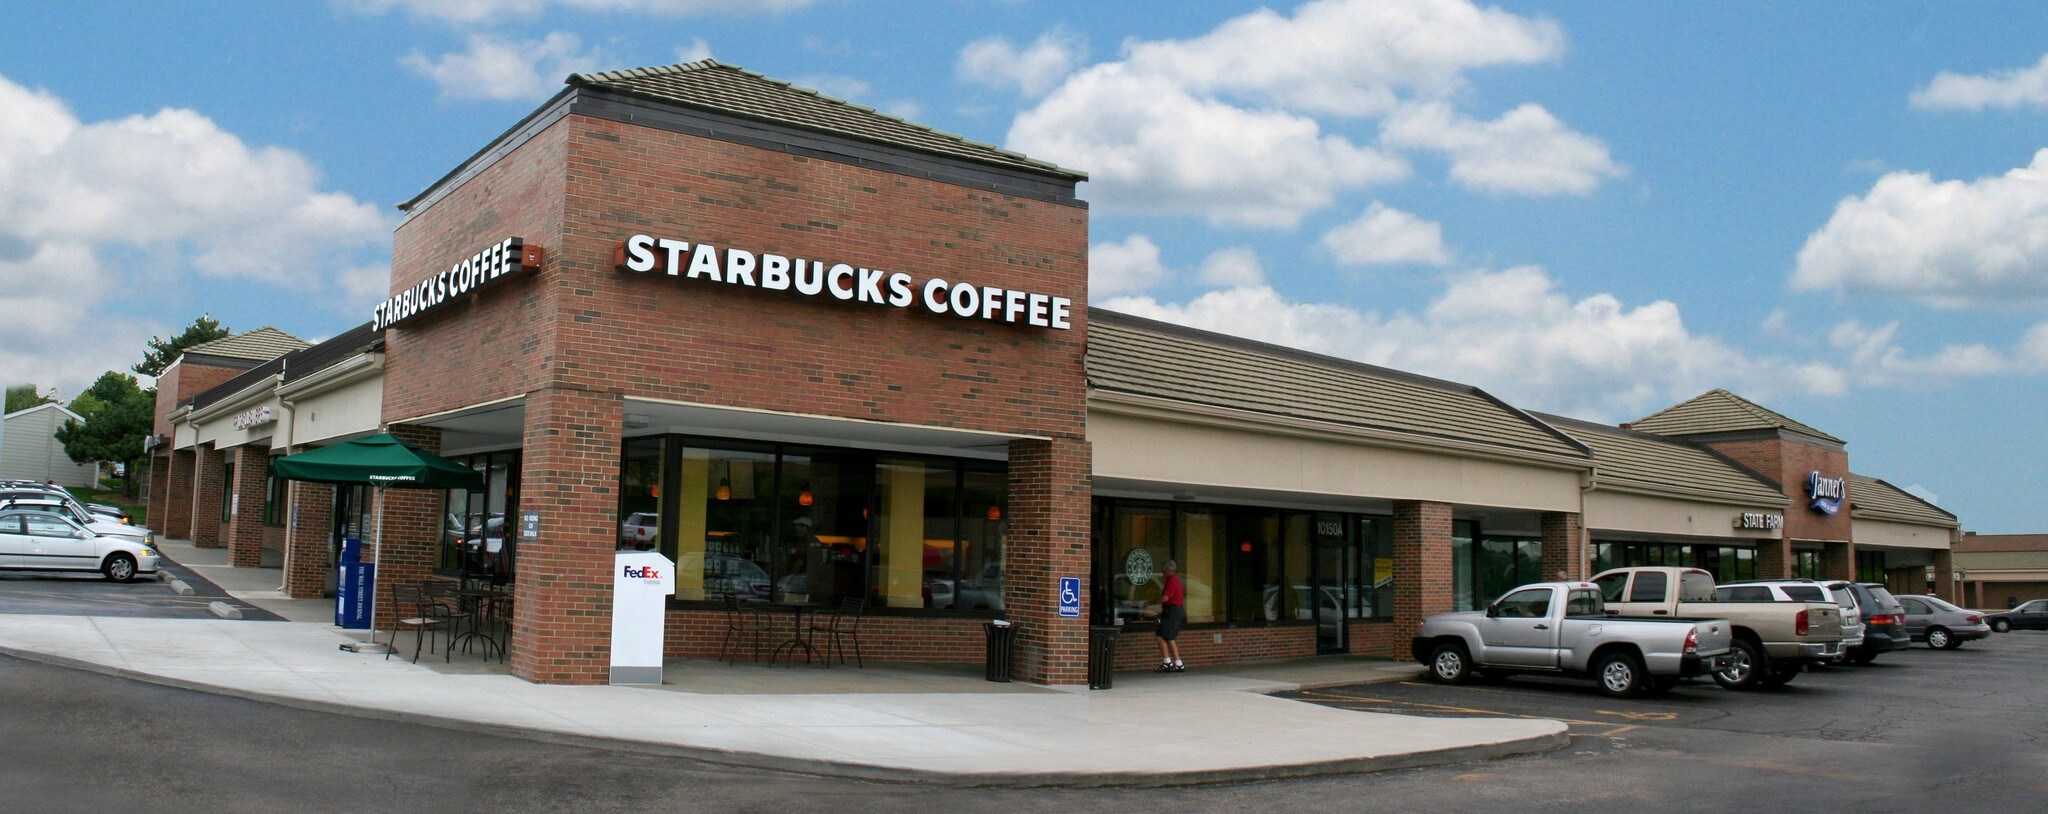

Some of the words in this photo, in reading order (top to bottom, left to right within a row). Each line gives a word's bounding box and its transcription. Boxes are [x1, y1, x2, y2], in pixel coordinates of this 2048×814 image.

[372, 271, 446, 332] STARBUCKS
[450, 237, 512, 297] COFFEE
[627, 234, 913, 307] STARBUCKS
[923, 278, 1071, 330] COFFEE
[1811, 470, 1846, 499] Tanner's
[1317, 522, 1343, 536] 10150A
[1743, 512, 1764, 528] STATE
[1766, 514, 1784, 529] FARM
[624, 565, 659, 579] FedEx
